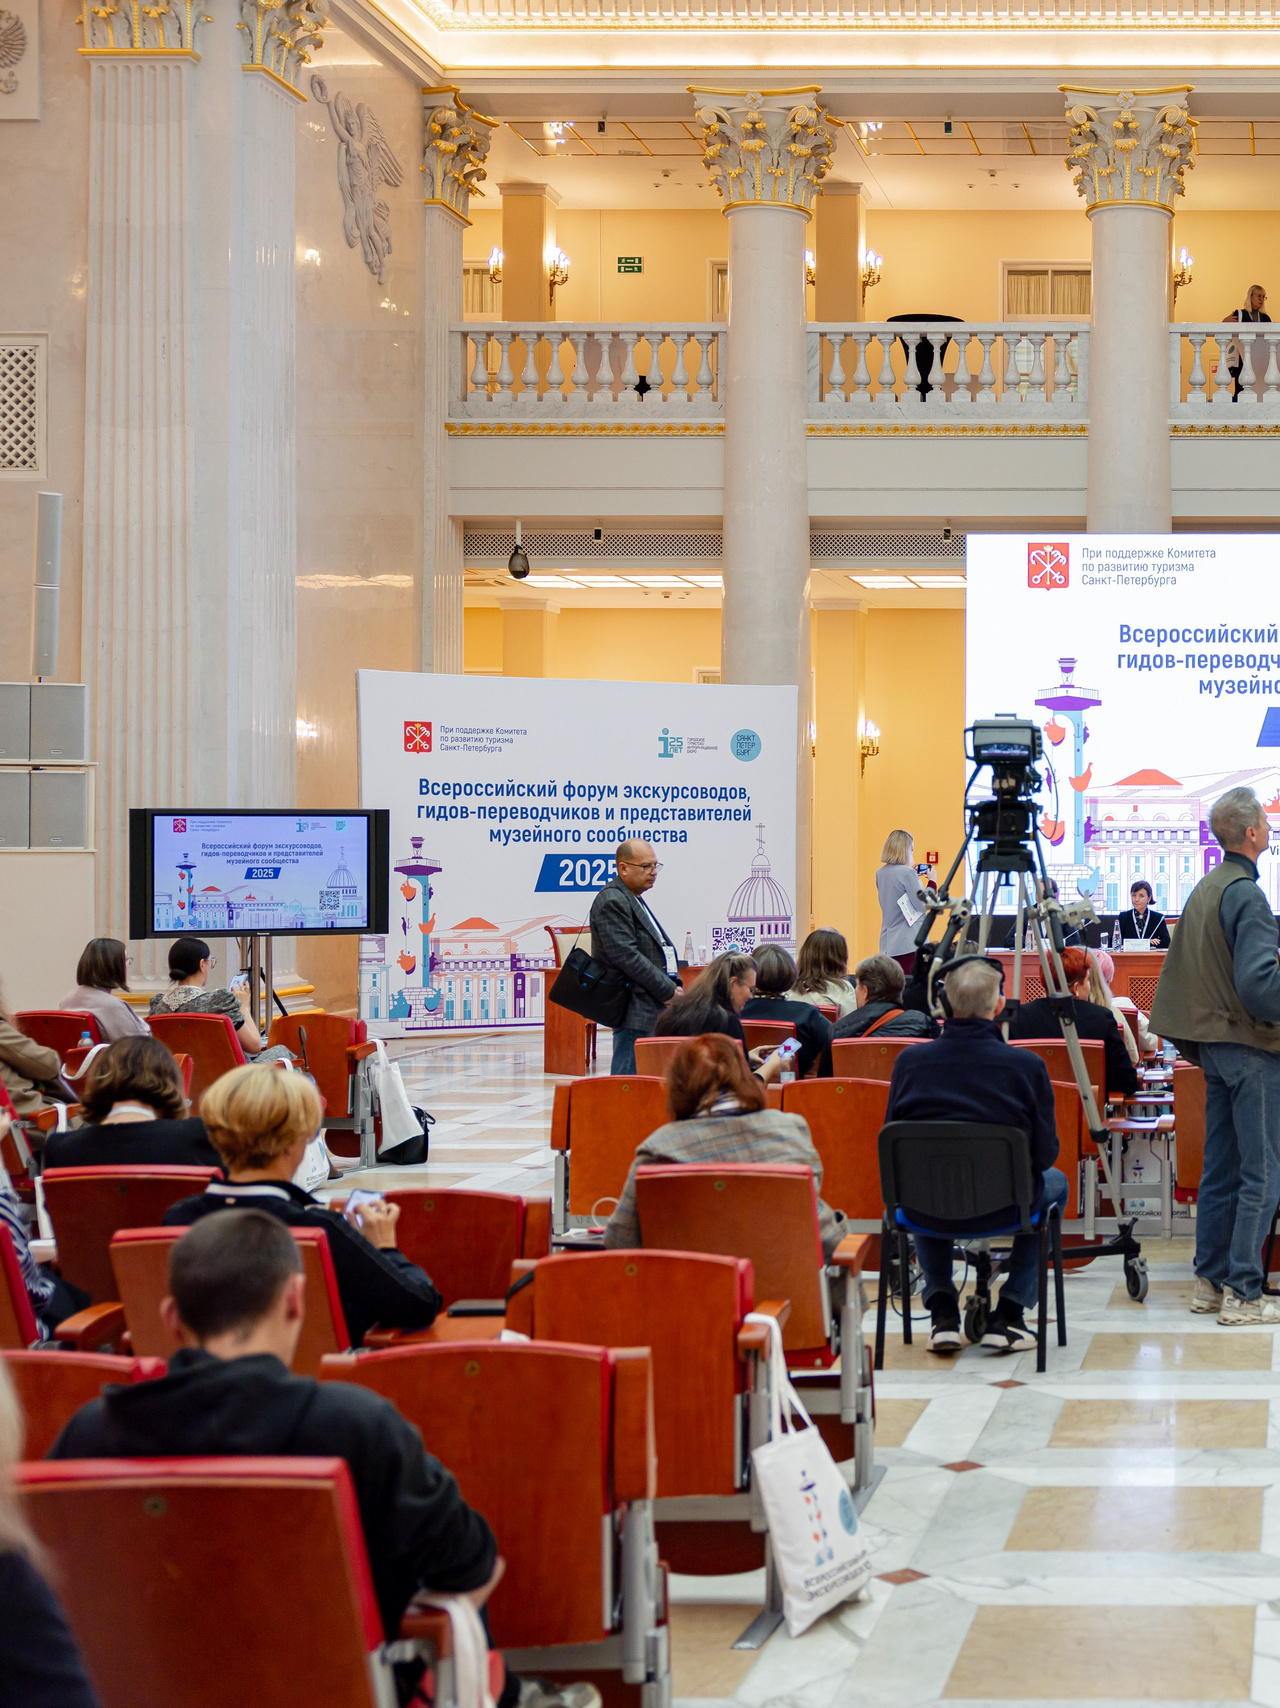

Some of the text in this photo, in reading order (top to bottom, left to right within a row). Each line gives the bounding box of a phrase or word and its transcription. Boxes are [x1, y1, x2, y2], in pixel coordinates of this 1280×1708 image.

[1082, 547, 1216, 560] При поддержке Комитета
[1082, 563, 1195, 574] по развитию туризма
[1081, 574, 1177, 587] Санкт-Петербурга
[1119, 623, 1278, 647] Всероссийский
[440, 725, 528, 736] При поддержке Комитета
[450, 736, 484, 744] развитию
[485, 737, 514, 745] туризма
[668, 736, 683, 747] 25
[736, 734, 755, 742] САНКТ
[440, 743, 503, 753] Санкт-Петербурга
[668, 746, 683, 754] ЛЕТ
[736, 741, 756, 749] ПЕТЕР
[736, 748, 752, 756] БУРГ
[419, 778, 751, 803] Всероссийский форум экскурсоводов,
[417, 804, 752, 824] гидов-переводчиков и представителей
[489, 824, 582, 847] музейного
[201, 842, 251, 850] Всероссийский
[252, 842, 274, 851] форум
[252, 868, 274, 878] 2025
